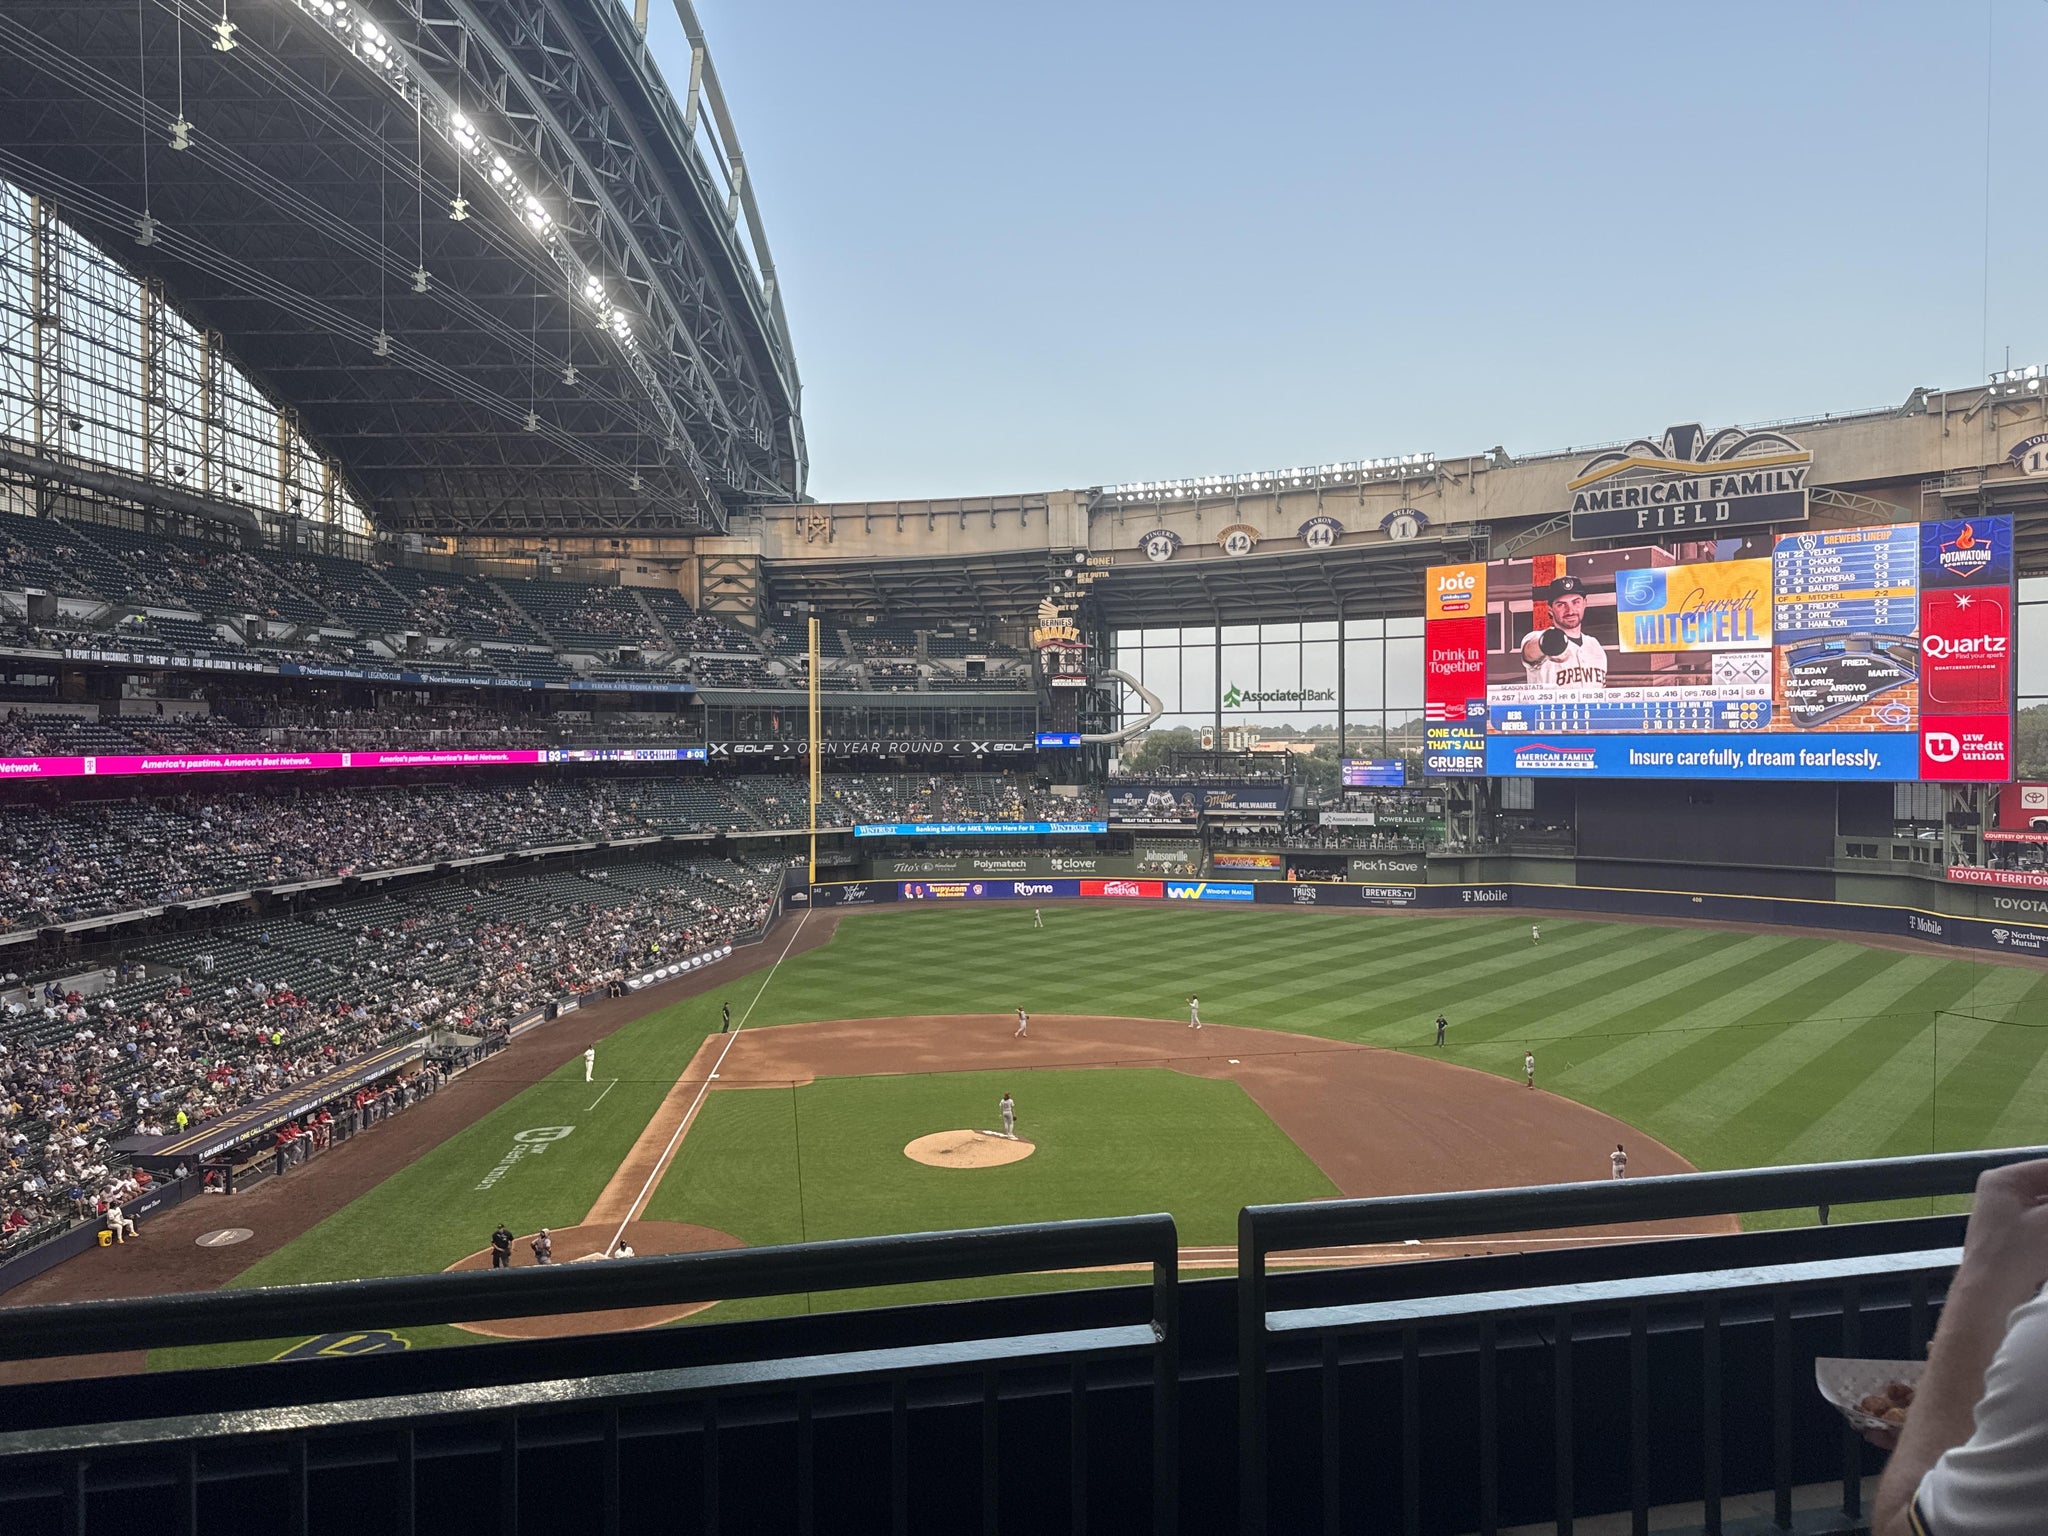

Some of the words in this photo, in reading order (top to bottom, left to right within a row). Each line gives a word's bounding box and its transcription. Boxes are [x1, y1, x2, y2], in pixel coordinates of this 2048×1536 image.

[1573, 480, 1699, 513] AMERICAN
[1710, 468, 1807, 498] FAMILY
[1392, 508, 1416, 518] SELIG
[1637, 501, 1730, 528] FIELD
[1308, 517, 1332, 527] AARON
[1145, 530, 1175, 540] FINGERS
[1399, 521, 1409, 538] 1
[1228, 536, 1248, 551] 42
[1310, 530, 1330, 546] 44
[1824, 533, 1862, 545] BREWERS
[1862, 531, 1892, 542] LINEUP
[1150, 541, 1169, 556] 34
[1808, 548, 1836, 556] YELICH
[1086, 557, 1114, 566] GONE!
[1808, 557, 1843, 566] CHOURIO
[1939, 550, 1991, 565] POTAWATOMI
[1809, 566, 1841, 575] TURANG
[1437, 571, 1476, 592] Joie
[1808, 574, 1856, 584] CONTRERAS
[1625, 575, 1655, 606] 5
[1808, 584, 1840, 592] BAUERS
[1897, 579, 1911, 587] HR
[1808, 593, 1846, 601] MITCHELL
[1679, 588, 1759, 621] Garrett
[1808, 602, 1840, 610] FRELICK
[1808, 611, 1831, 619] ORTIZ
[1041, 618, 1073, 627] BERNIE'S
[1634, 608, 1760, 645] MITCHELL
[1808, 619, 1848, 628] HAMILTON
[1033, 626, 1080, 641] CHALET
[1922, 634, 2006, 659] Quartz
[72, 650, 91, 660] REPORT
[91, 651, 101, 661] FAN
[133, 654, 144, 664] TEXT
[171, 656, 191, 667] (SPACE)
[1432, 648, 1466, 662] Drink
[1467, 647, 1480, 660] in
[1955, 652, 1970, 660] Find
[1986, 652, 2005, 660] spark.
[1428, 660, 1483, 675] Together
[1841, 659, 1872, 667] FRIEDL
[306, 667, 344, 677] Northwestern
[344, 669, 363, 678] Mutual
[368, 671, 389, 680] LEGENDS
[389, 672, 401, 681] CLUB
[1794, 667, 1828, 675] BLEDAY
[1868, 669, 1900, 678] MARTE
[1811, 678, 1834, 687] CRUZ
[1829, 683, 1867, 692] ARROYO
[1784, 686, 1818, 698] SUÁREZ
[1827, 694, 1870, 703] STEWART
[1467, 706, 1485, 717] 250
[1726, 702, 1740, 710] BALL
[1788, 705, 1825, 713] TREVINO
[1721, 711, 1740, 719] STRIKE
[1728, 720, 1740, 728] OUT
[1427, 728, 1450, 738] ONE
[1450, 728, 1484, 738] CALL...
[1962, 733, 1985, 742] uw
[709, 743, 729, 755] X
[733, 744, 774, 754] GOLF
[843, 742, 881, 754] YEAR
[889, 742, 944, 754] ROUND
[970, 742, 990, 754] X
[993, 743, 1033, 752] GOLF
[1426, 740, 1462, 750] THAT'S
[1462, 740, 1485, 750] ALL!
[1962, 741, 2004, 751] credit
[548, 750, 561, 761] 93
[1515, 753, 1560, 761] AMERICAN
[1562, 753, 1595, 761] FAMILY
[1629, 748, 1674, 765] Insure
[1677, 748, 1744, 769] carefully,
[1747, 748, 1796, 766] dream
[1798, 748, 1882, 769] fearlessly.
[1962, 751, 2005, 761] union
[0, 761, 42, 774] Network.
[141, 758, 186, 770] America's
[186, 759, 223, 770] pastime.
[223, 757, 263, 768] America's
[263, 757, 280, 767] Best
[280, 756, 312, 767] Network.
[1428, 756, 1483, 769] GRUBER
[1204, 793, 1237, 808] Miller
[1403, 816, 1425, 824] ALLEY
[860, 826, 897, 835] WINTRUST
[941, 825, 956, 833] Built
[968, 825, 984, 833] MKE,
[1050, 823, 1092, 832] WINTRUST
[1144, 850, 1188, 862] Johnsonville
[894, 862, 920, 873] Tito's
[973, 860, 1027, 869] Polymatech
[1063, 858, 1096, 868] clover
[1220, 856, 1255, 868] Surfside
[1388, 860, 1418, 872] Save
[1949, 869, 1993, 881] TOYOTA
[930, 885, 967, 894] hupy.com
[1014, 882, 1054, 897] Rhyme
[1104, 882, 1139, 896] festival
[1292, 887, 1316, 898] TRUSS
[1473, 889, 1508, 901] Mobile
[1992, 897, 2048, 913] TOYOTA
[1917, 917, 1942, 936] Mobile
[2011, 938, 2040, 948] Mutual
[203, 1143, 224, 1158] GRUBER
[223, 1138, 235, 1150] LAW
